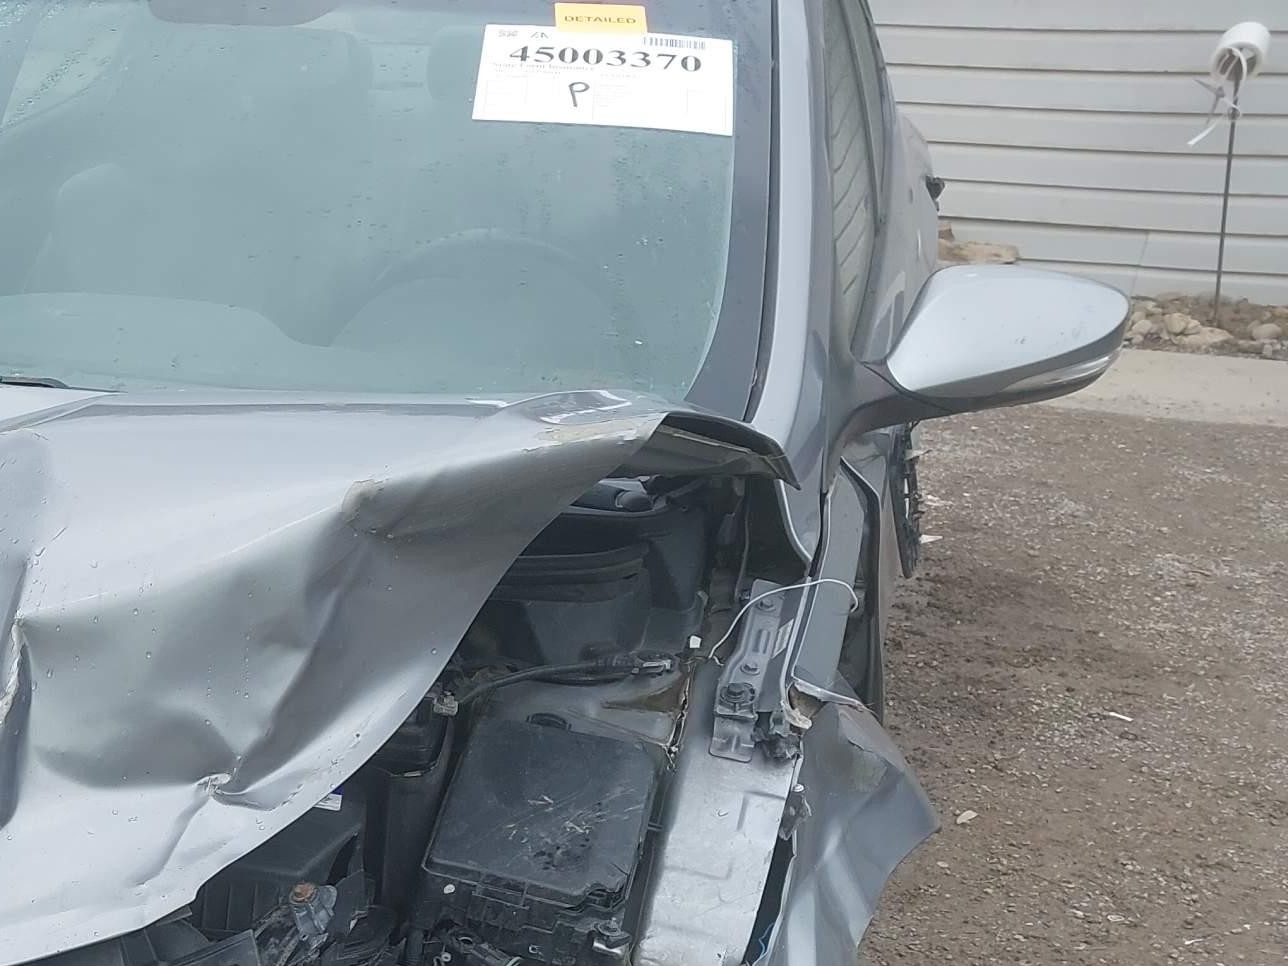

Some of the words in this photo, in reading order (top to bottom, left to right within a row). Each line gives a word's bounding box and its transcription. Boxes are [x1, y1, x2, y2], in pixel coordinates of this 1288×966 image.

[564, 15, 637, 24] DETAILED
[509, 45, 702, 72] 45003370
[568, 81, 590, 107] P
